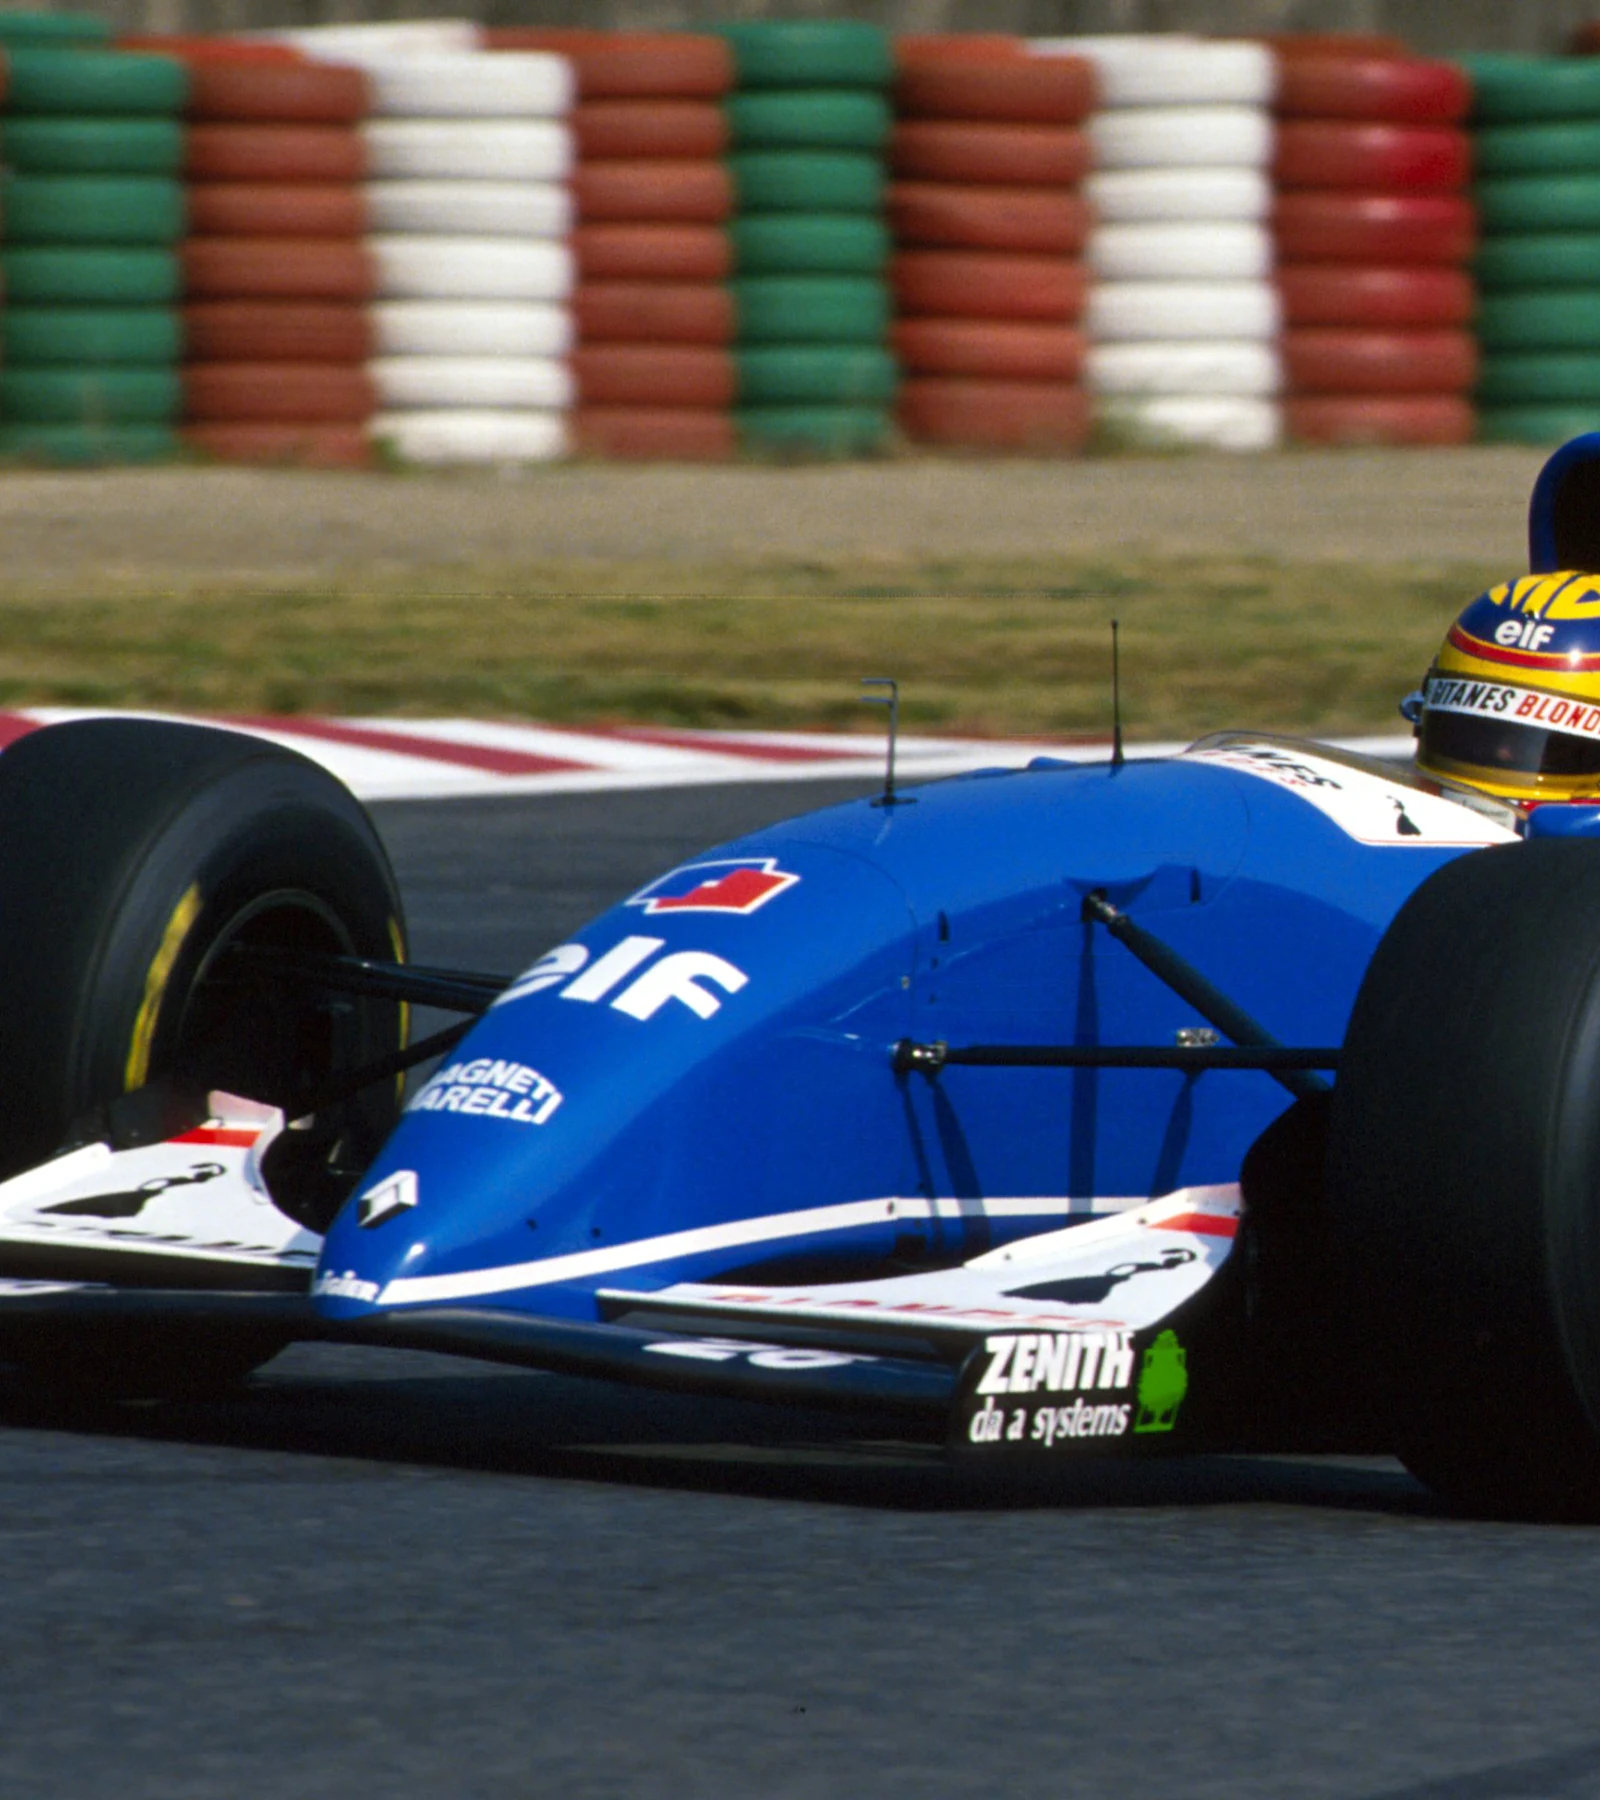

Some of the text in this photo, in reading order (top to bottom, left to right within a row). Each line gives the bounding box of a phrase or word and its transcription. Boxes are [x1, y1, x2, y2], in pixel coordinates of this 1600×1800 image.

[1495, 620, 1556, 651] elf
[975, 1332, 1135, 1395] ZENITH
[1007, 1409, 1027, 1440] a
[1030, 1398, 1132, 1447] systems
